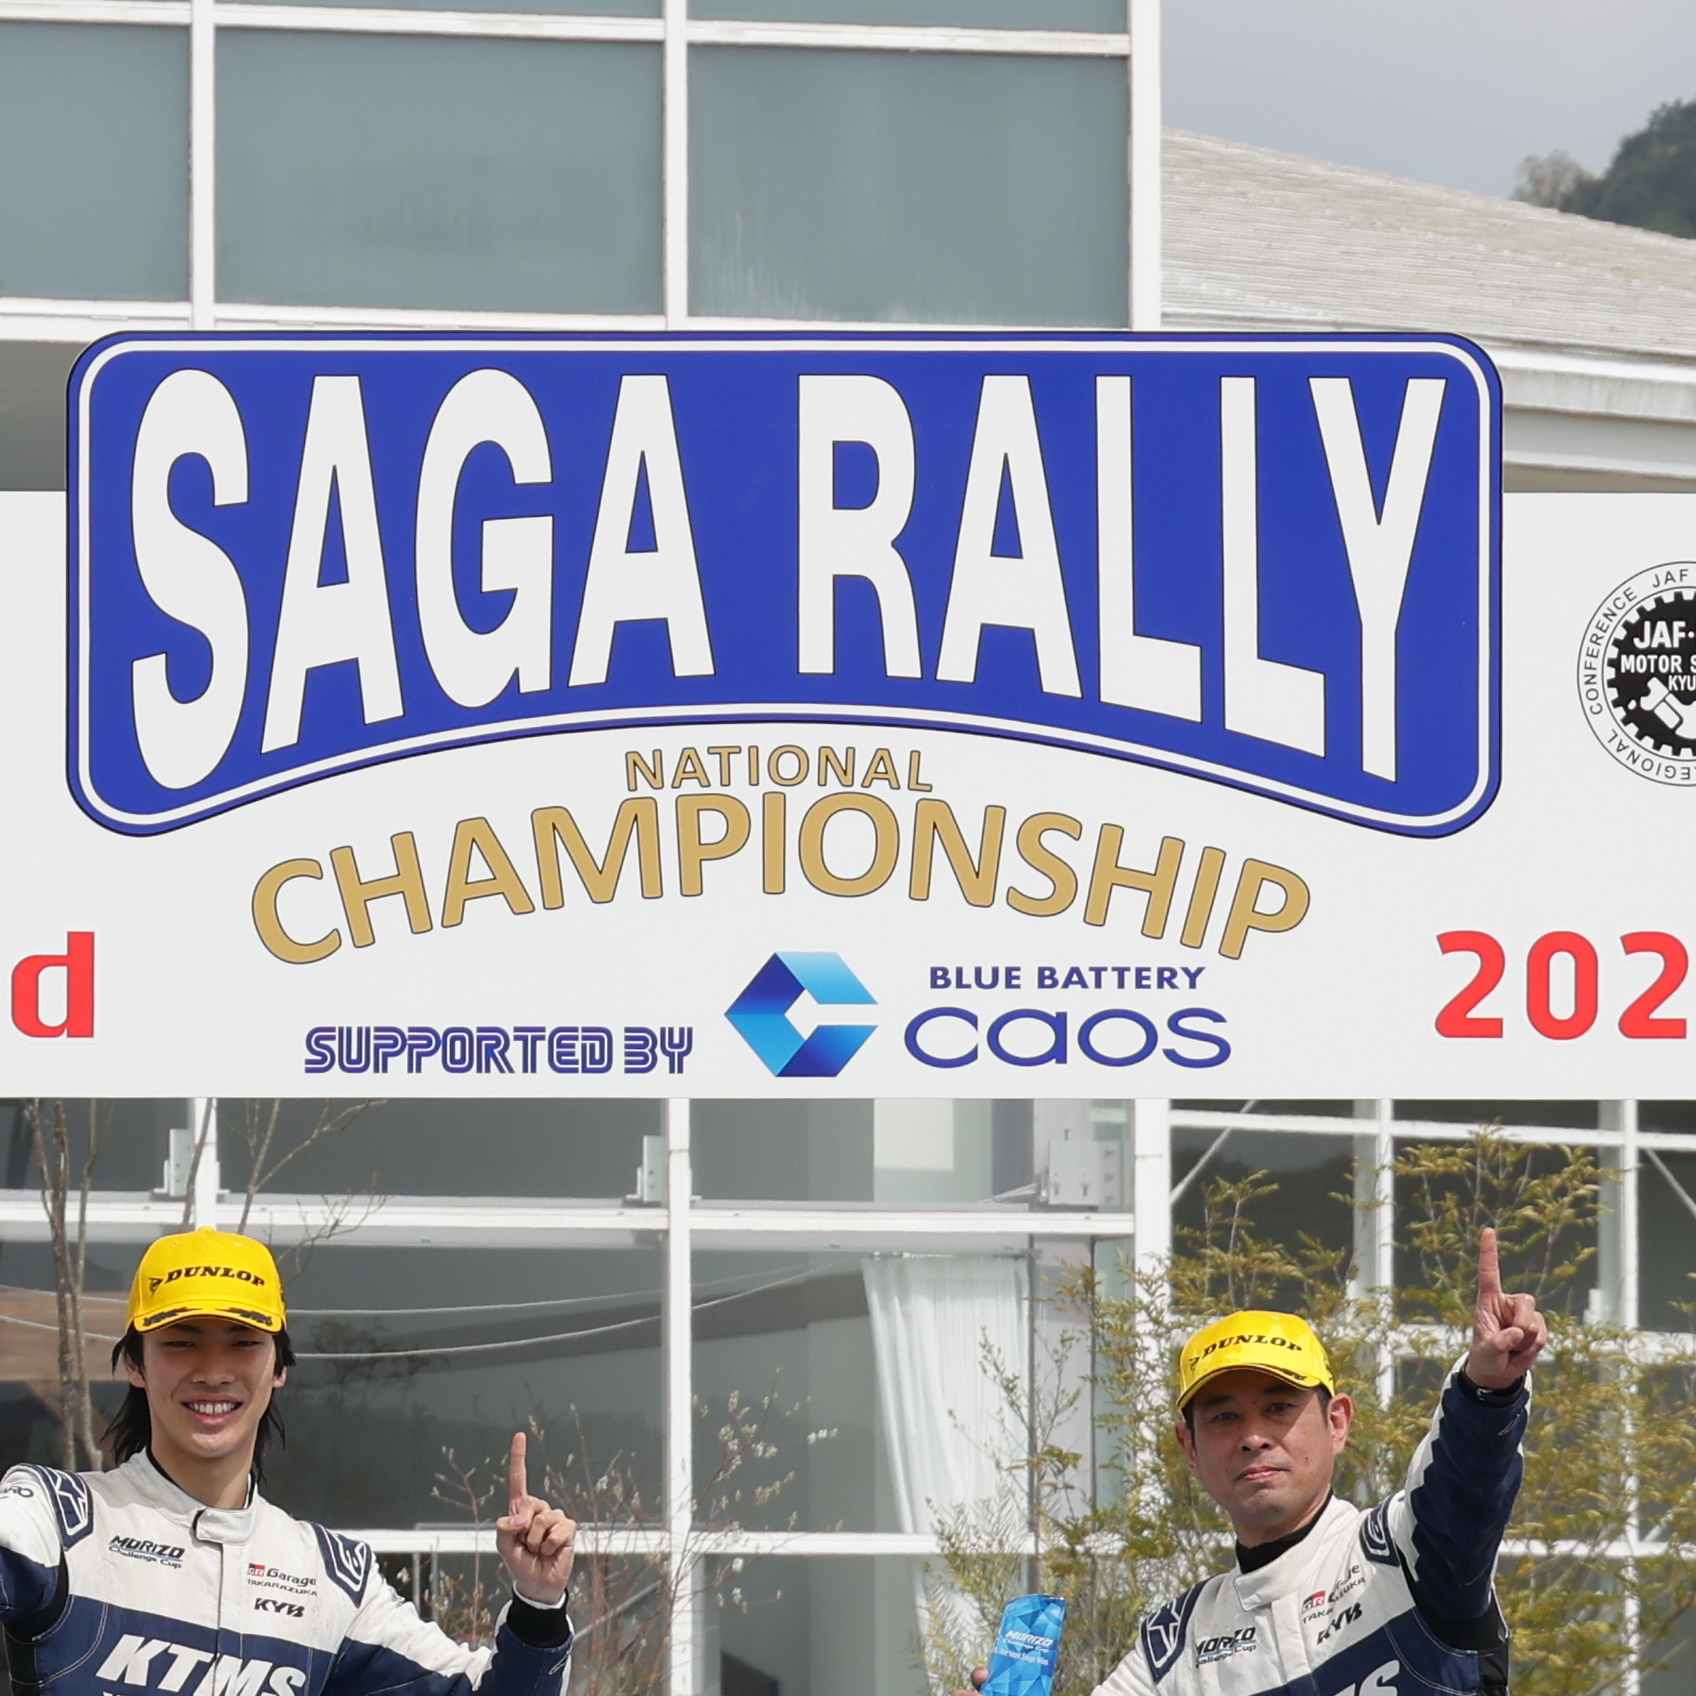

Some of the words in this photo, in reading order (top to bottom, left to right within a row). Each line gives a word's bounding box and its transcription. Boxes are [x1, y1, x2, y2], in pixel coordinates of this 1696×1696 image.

[131, 367, 715, 790] SAGA
[797, 372, 1447, 782] RALLY
[1652, 568, 1689, 588] JAF
[1584, 587, 1637, 716] CONFERENCE
[1620, 655, 1682, 673] MOTOR
[624, 743, 935, 794] NATIONAL
[250, 790, 1312, 965] CHAMPIONSHIP
[928, 965, 1025, 991] BLUE
[1037, 965, 1206, 991] BATTERY
[305, 1026, 613, 1075] SUPPORTED
[623, 1025, 693, 1075] BY
[903, 1006, 1232, 1070] caos
[165, 1265, 266, 1288] DUNLOP
[1202, 1333, 1302, 1361] DUNLOP
[108, 1535, 185, 1559] MORIZO
[266, 1568, 317, 1587] Garage
[254, 1597, 305, 1618] KYB
[1006, 1630, 1054, 1647] MORIZO
